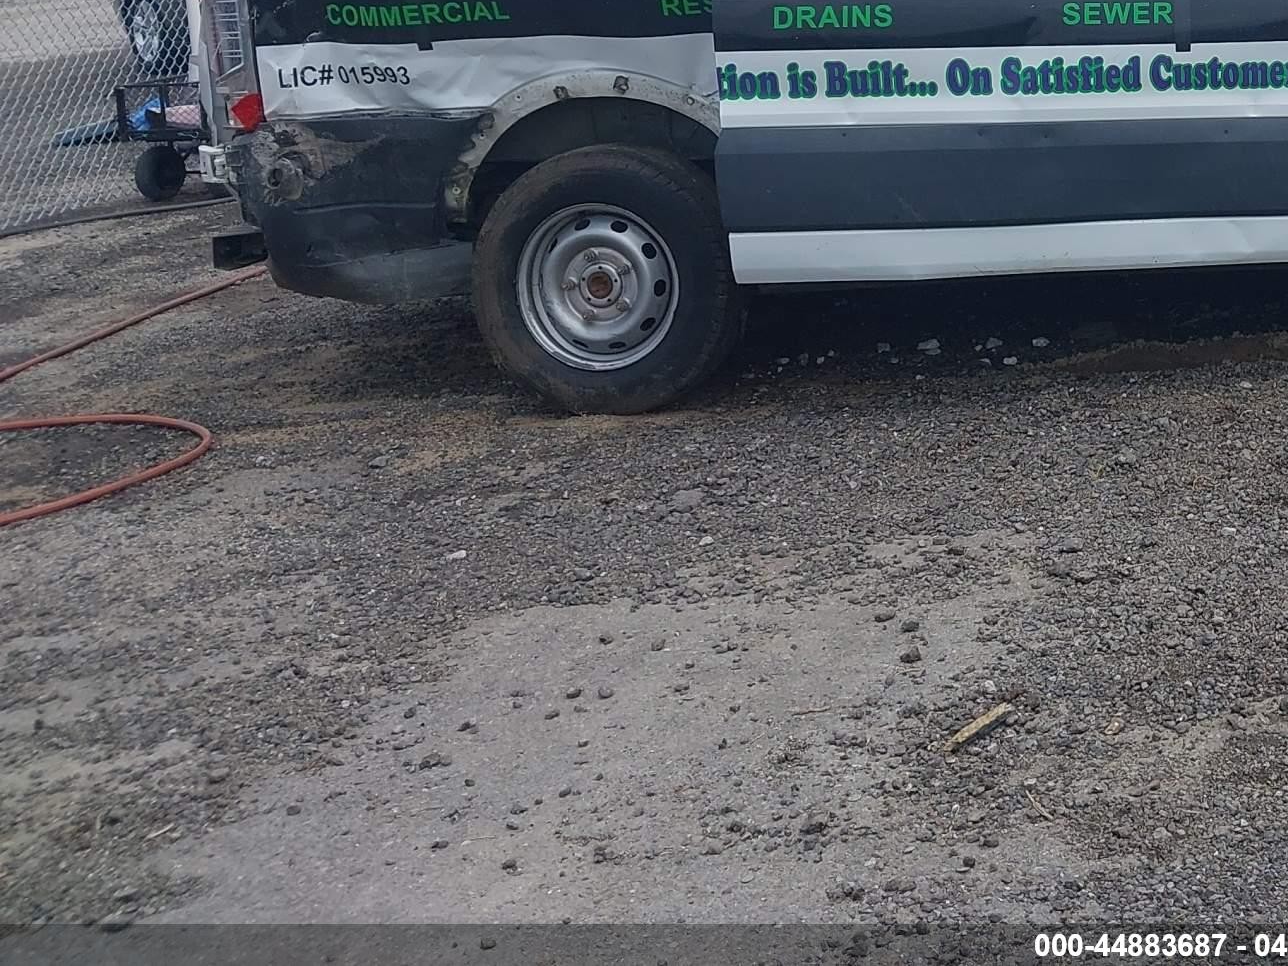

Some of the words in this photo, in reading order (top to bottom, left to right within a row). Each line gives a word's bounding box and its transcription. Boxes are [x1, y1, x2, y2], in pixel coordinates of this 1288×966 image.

[325, 1, 511, 28] COMMERCIAL
[772, 4, 893, 31] DRAINS
[1062, 1, 1175, 27] SEWER
[787, 61, 818, 99] is
[823, 59, 940, 98] Built...
[945, 57, 994, 96] On
[1000, 55, 1143, 95] Satisfied
